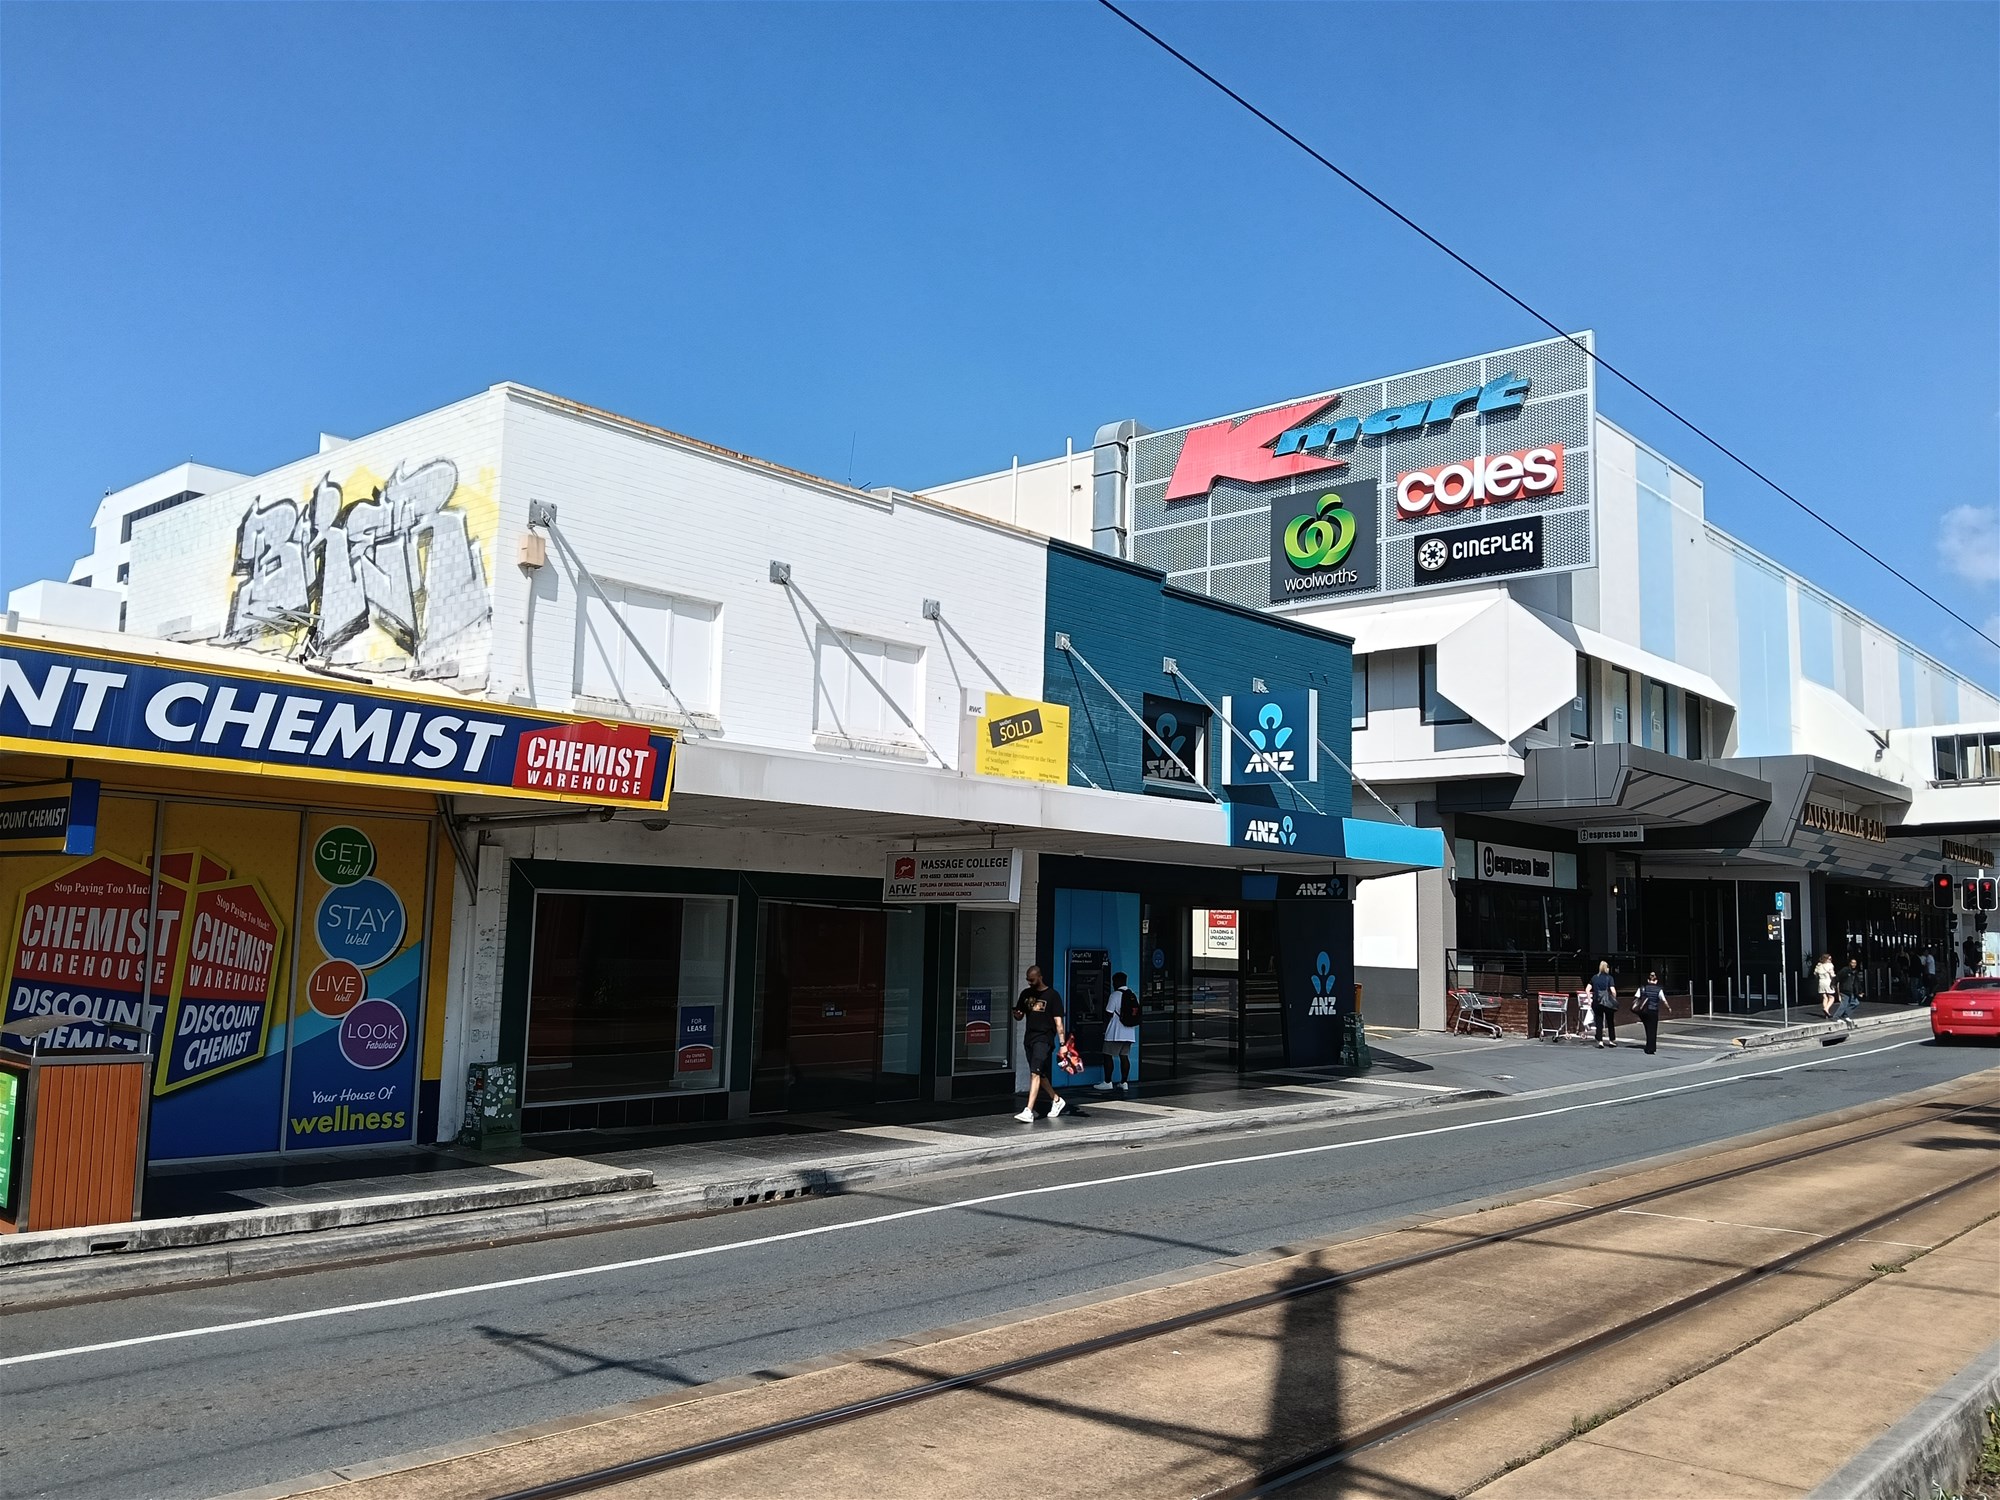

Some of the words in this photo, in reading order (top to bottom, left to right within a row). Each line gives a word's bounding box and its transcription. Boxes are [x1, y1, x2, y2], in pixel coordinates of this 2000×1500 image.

[1164, 371, 1531, 501] Kmart
[1397, 448, 1559, 514] coles
[1453, 531, 1534, 560] CINEPLEX
[1285, 568, 1358, 593] Woolworths
[145, 681, 505, 772] CHEMIST
[1000, 720, 1032, 741] SOLD
[527, 736, 649, 778] CHEMIST
[1244, 750, 1295, 774] ANZ
[527, 770, 641, 795] WAREHOUSE
[28, 807, 67, 828] CHEMIST
[1804, 803, 1865, 839] AUSTRALIA
[1244, 819, 1280, 844] ANZ
[1589, 830, 1621, 840] espresso
[1622, 829, 1638, 838] lane
[319, 840, 368, 863] GET
[336, 863, 362, 876] Well
[920, 859, 964, 870] MASSAGE
[966, 857, 1009, 869] COLLEGE
[1494, 855, 1532, 876] espresso
[54, 881, 73, 894] Stop
[75, 882, 104, 895] Paying
[106, 883, 124, 894] Too
[888, 883, 918, 895] AFWE
[1295, 883, 1327, 896] ANZ
[216, 894, 230, 913] Stop
[326, 904, 395, 933] STAY
[22, 904, 180, 957] CHEMIST
[344, 932, 371, 946] Well
[191, 911, 274, 975] CHEMIST
[20, 949, 167, 984] WAREHOUSE
[189, 964, 266, 993] WAREHOUSE
[315, 975, 357, 993] LIVE
[334, 993, 351, 1002] Well
[1308, 997, 1337, 1016] ANZ
[13, 986, 164, 1034] DISCOUNT
[178, 1004, 260, 1037] DISCOUNT
[347, 1023, 400, 1039] LOOK
[686, 1025, 707, 1033] LEASE
[183, 1031, 252, 1071] CHEMIST
[365, 1040, 398, 1051] Fabulous
[312, 1090, 338, 1104] Your
[339, 1088, 376, 1102] House
[378, 1086, 396, 1100] Of
[290, 1105, 406, 1135] wellness
